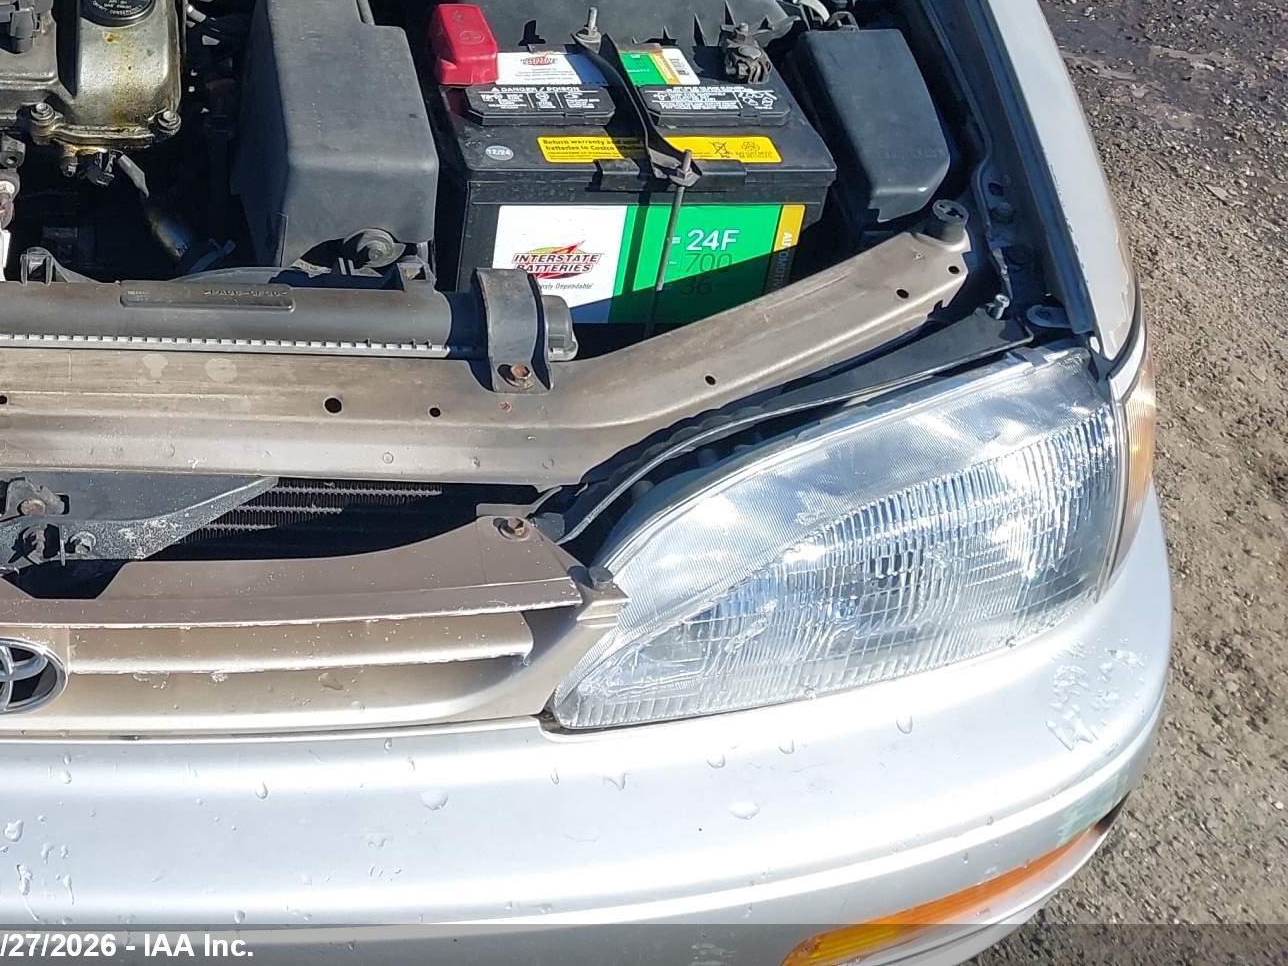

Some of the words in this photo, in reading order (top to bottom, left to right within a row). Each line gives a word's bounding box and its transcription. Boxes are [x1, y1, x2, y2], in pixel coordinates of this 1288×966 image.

[686, 229, 740, 251] 24F
[514, 254, 599, 264] INTERSTATE
[684, 252, 733, 273] 700
[516, 264, 592, 273] BATTERIES
